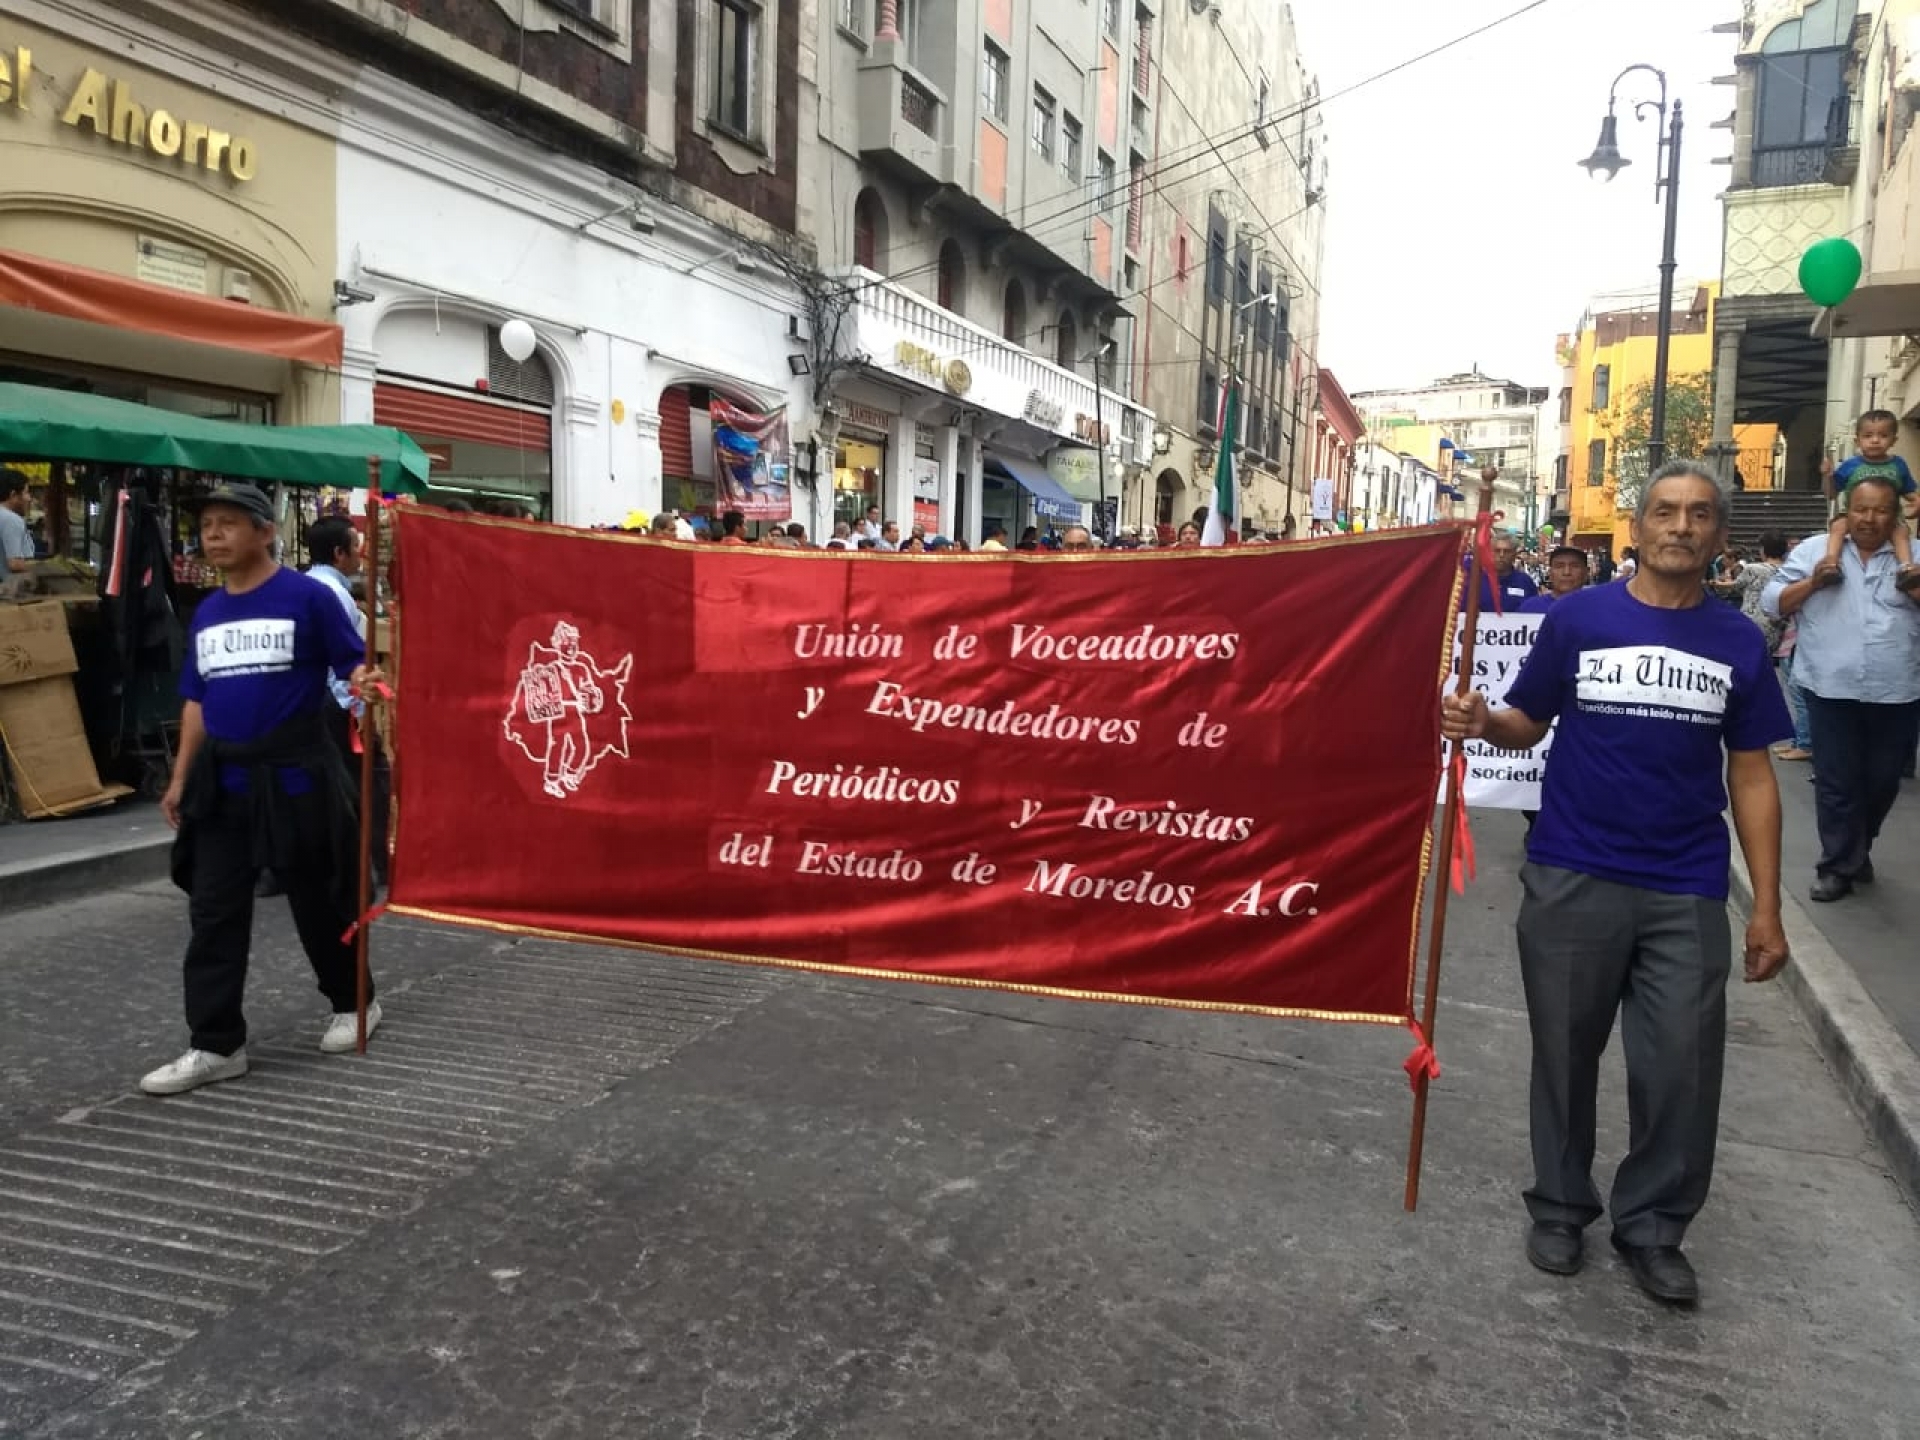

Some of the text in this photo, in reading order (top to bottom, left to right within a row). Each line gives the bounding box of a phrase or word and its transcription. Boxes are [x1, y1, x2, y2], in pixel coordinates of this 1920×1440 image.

[62, 67, 257, 180] Ahorro
[225, 624, 286, 653] Unión
[794, 623, 1239, 660] Unión de Voceadores
[1496, 661, 1510, 681] y
[1587, 654, 1728, 696] La Unión
[797, 681, 1227, 747] y Expendedores de
[1625, 706, 1649, 717] más
[765, 760, 1254, 841] Periódicos y Revistas
[719, 833, 1319, 916] del Estado de Morelos A.C.
